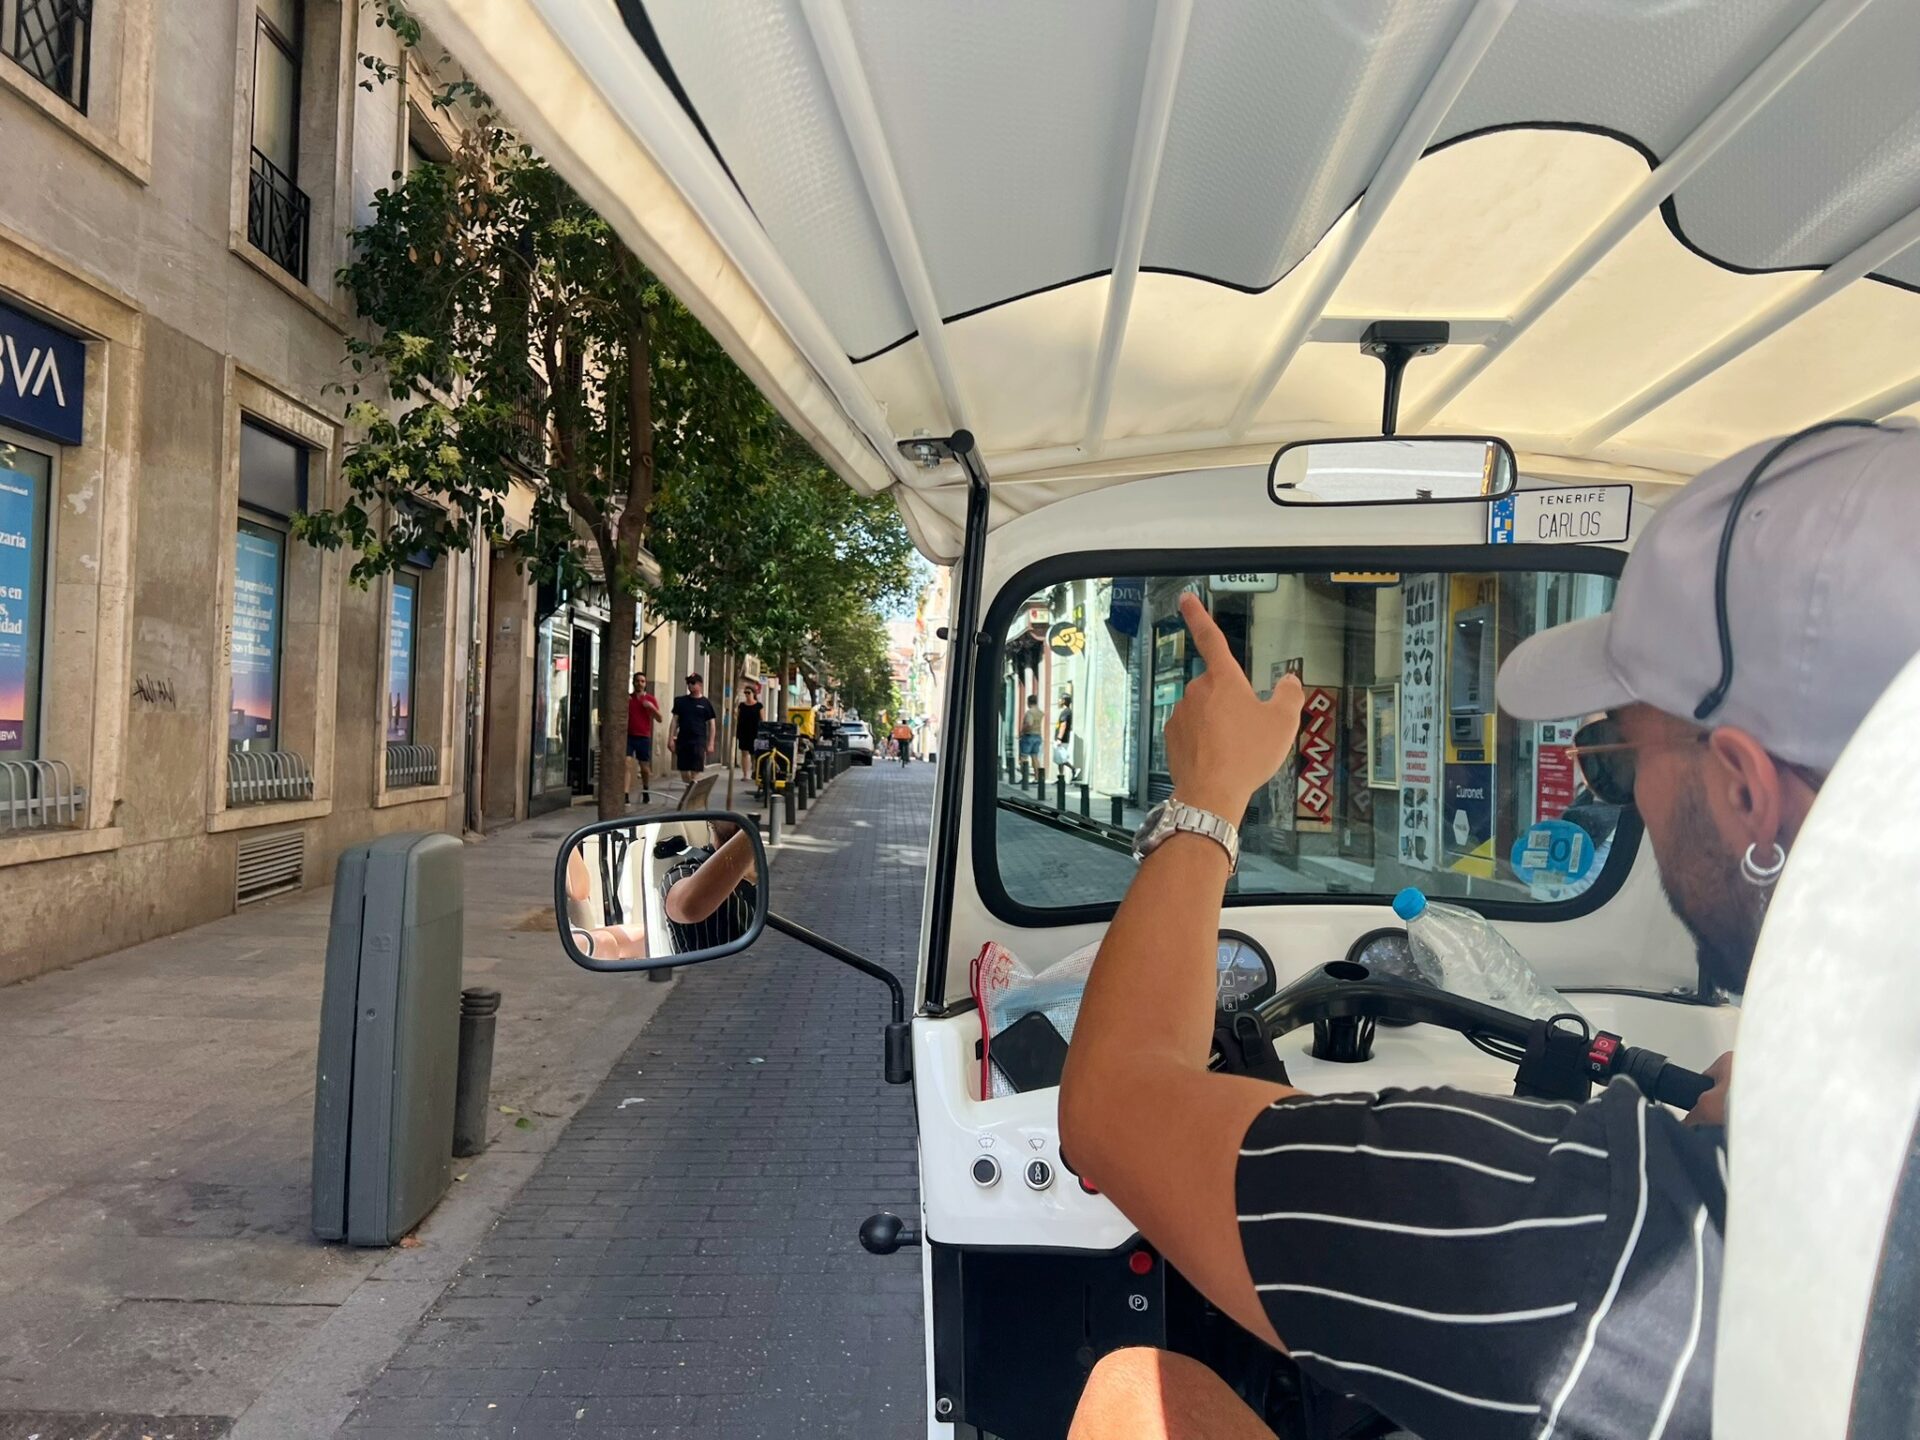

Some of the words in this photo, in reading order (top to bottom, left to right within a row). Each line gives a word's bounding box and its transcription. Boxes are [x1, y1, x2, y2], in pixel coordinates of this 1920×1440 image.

[0, 334, 66, 407] VA
[1496, 530, 1508, 543] E
[1538, 510, 1602, 539] CARLOS
[1304, 693, 1332, 812] PIZZA
